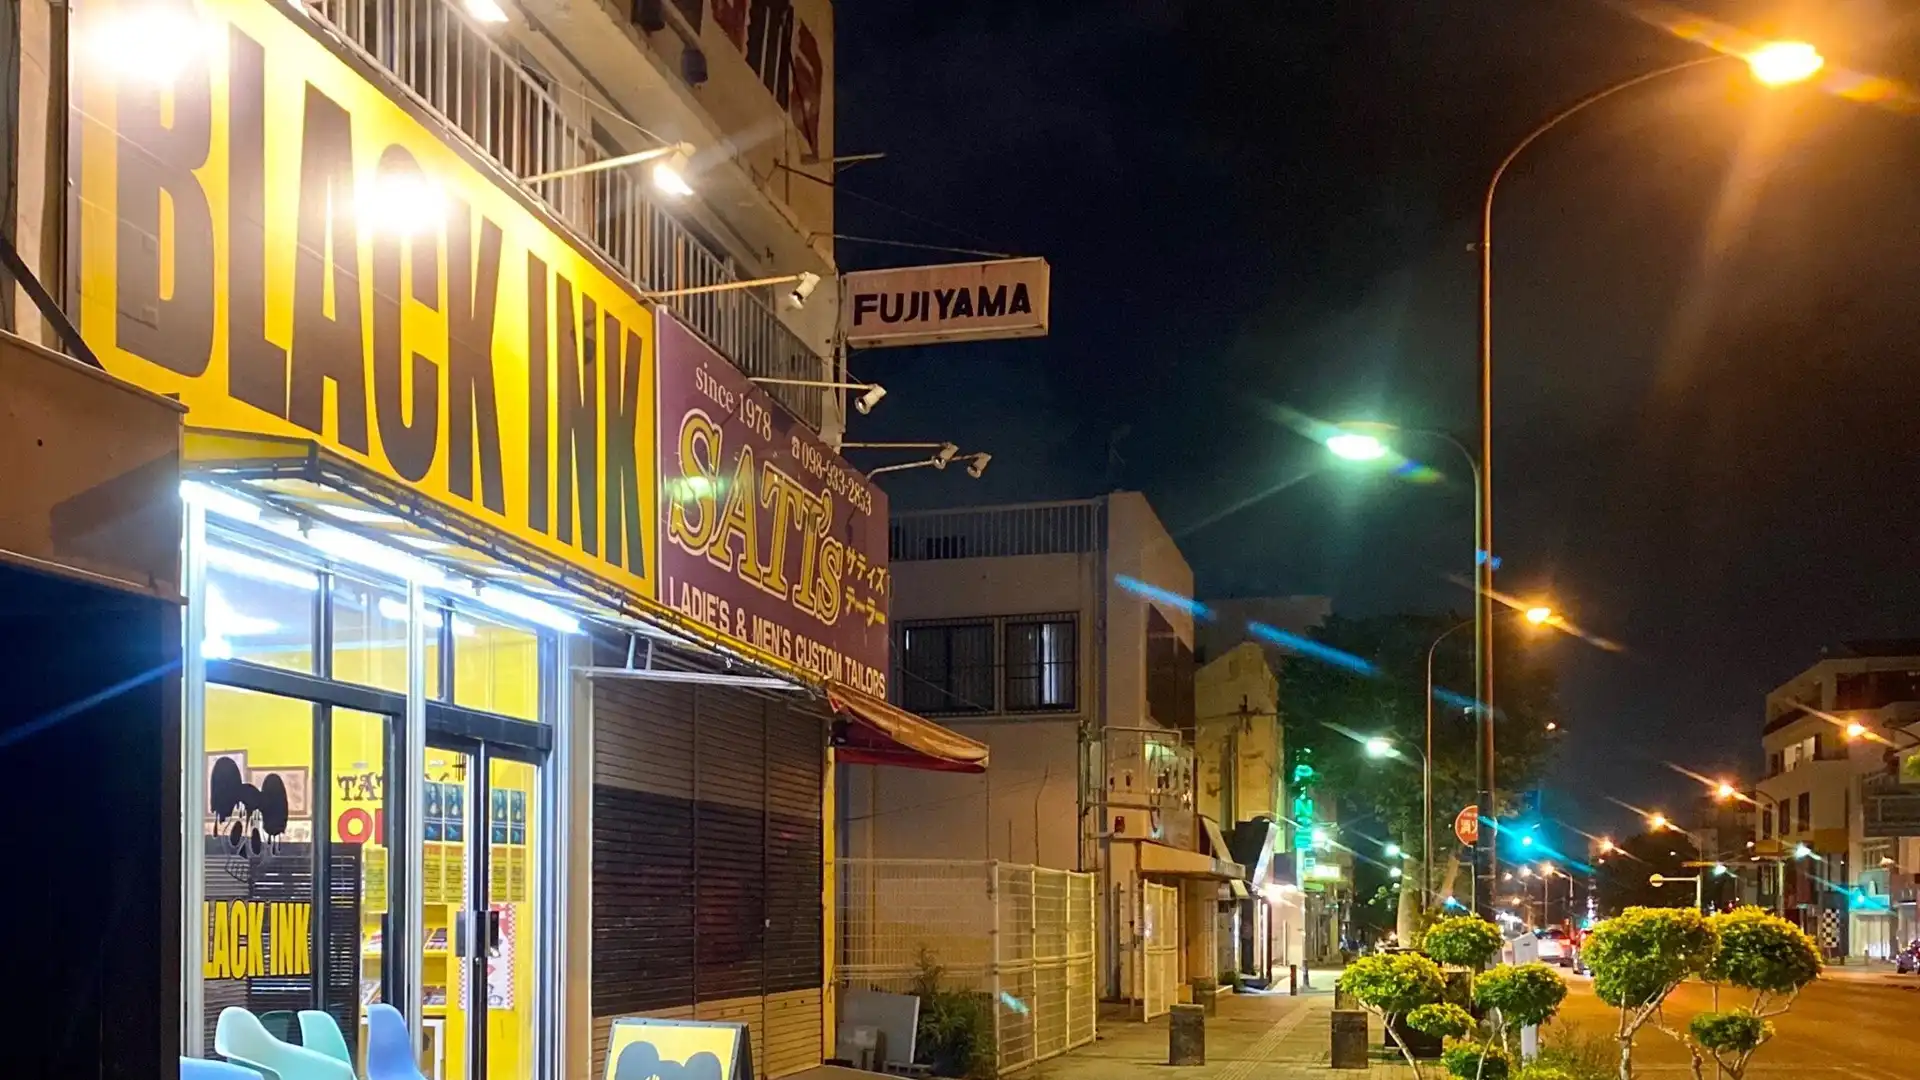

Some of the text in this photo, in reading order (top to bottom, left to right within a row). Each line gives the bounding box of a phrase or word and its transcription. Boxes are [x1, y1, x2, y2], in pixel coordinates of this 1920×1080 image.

[115, 10, 645, 579] BLACK INK
[853, 282, 1032, 327] FUJIYAMA
[695, 361, 772, 442] since 1978
[668, 577, 886, 700] LADIE'S & MEN'S CUSTOM TAILORS
[845, 585, 886, 627] テーラー
[270, 901, 311, 977] INK
